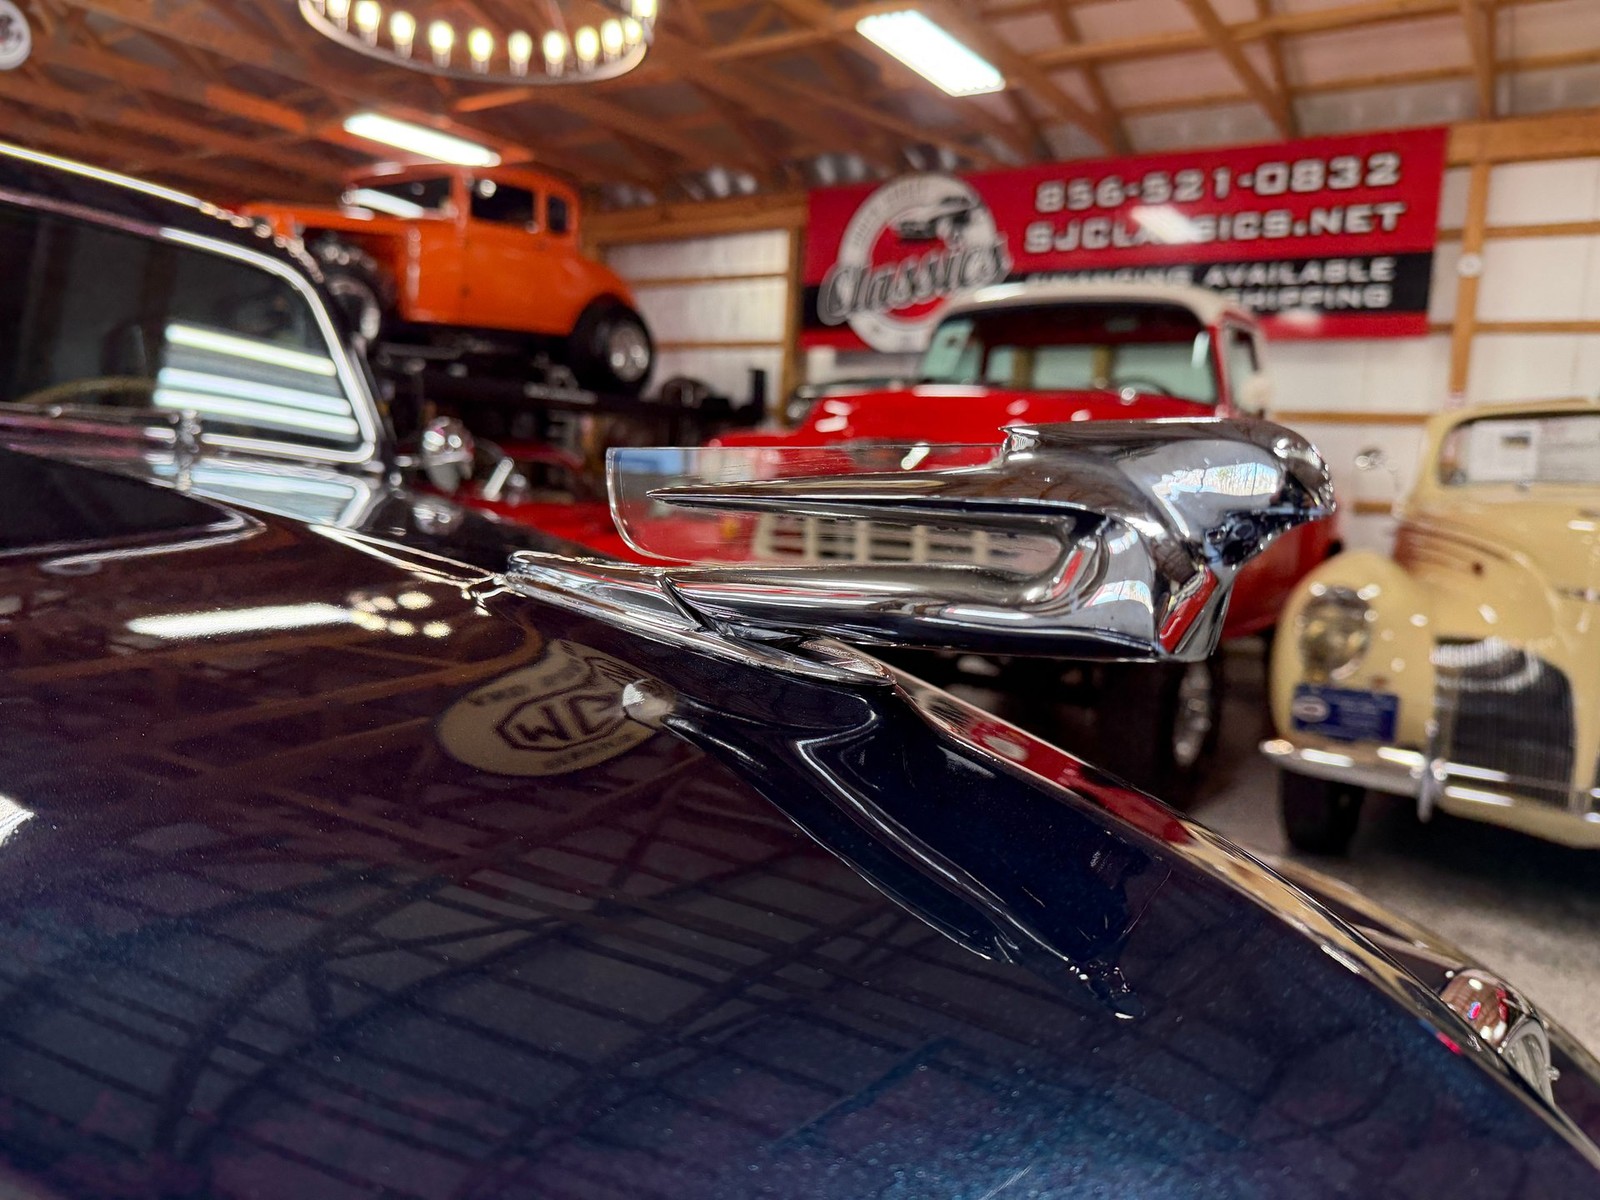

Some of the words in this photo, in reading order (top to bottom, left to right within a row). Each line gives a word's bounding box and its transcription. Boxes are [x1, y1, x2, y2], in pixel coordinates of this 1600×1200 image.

[1035, 152, 1400, 214] 856-521-0832
[1024, 201, 1406, 254] SJCLSICS.NET
[1203, 256, 1397, 288] AVAILABLE
